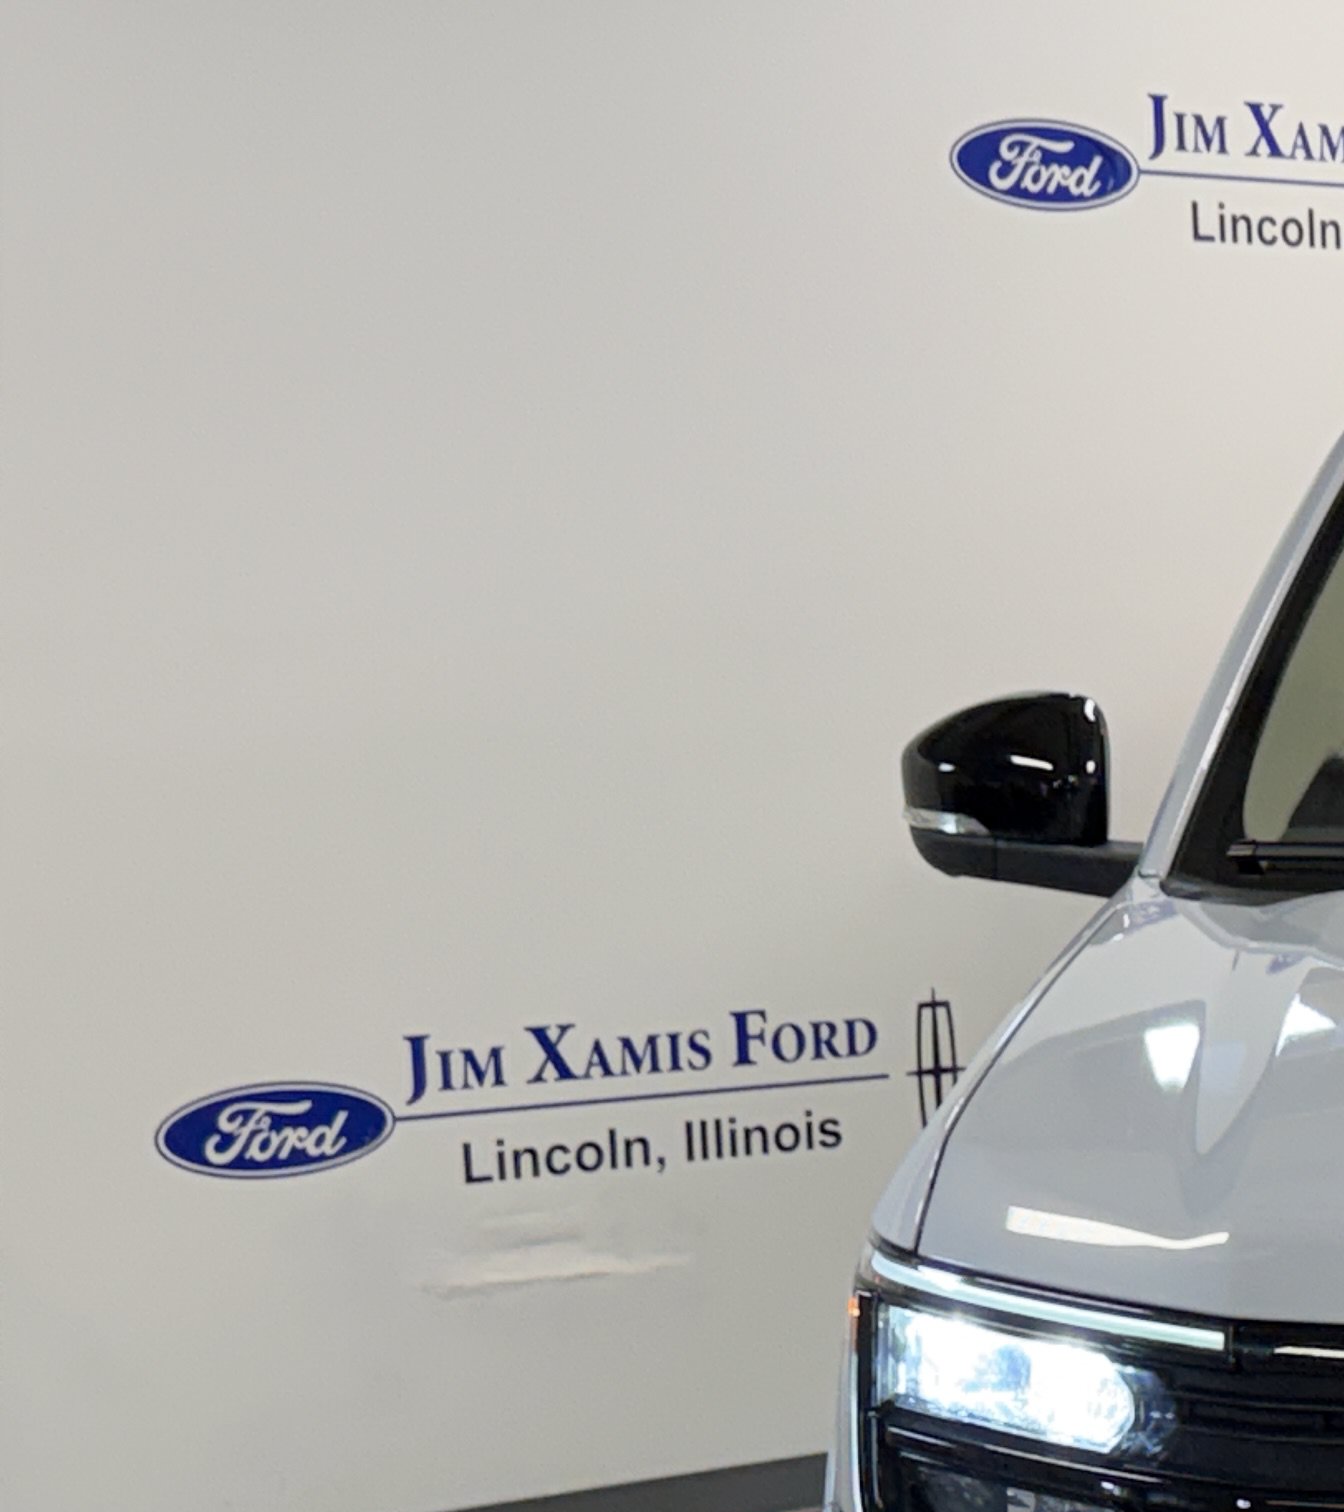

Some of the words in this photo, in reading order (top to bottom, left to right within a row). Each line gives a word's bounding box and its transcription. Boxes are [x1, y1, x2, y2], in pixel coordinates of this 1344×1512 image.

[989, 131, 1102, 199] Ford
[204, 1099, 347, 1167] Ford
[462, 1127, 666, 1185] Lincoln,
[684, 1109, 843, 1162] Illinois
